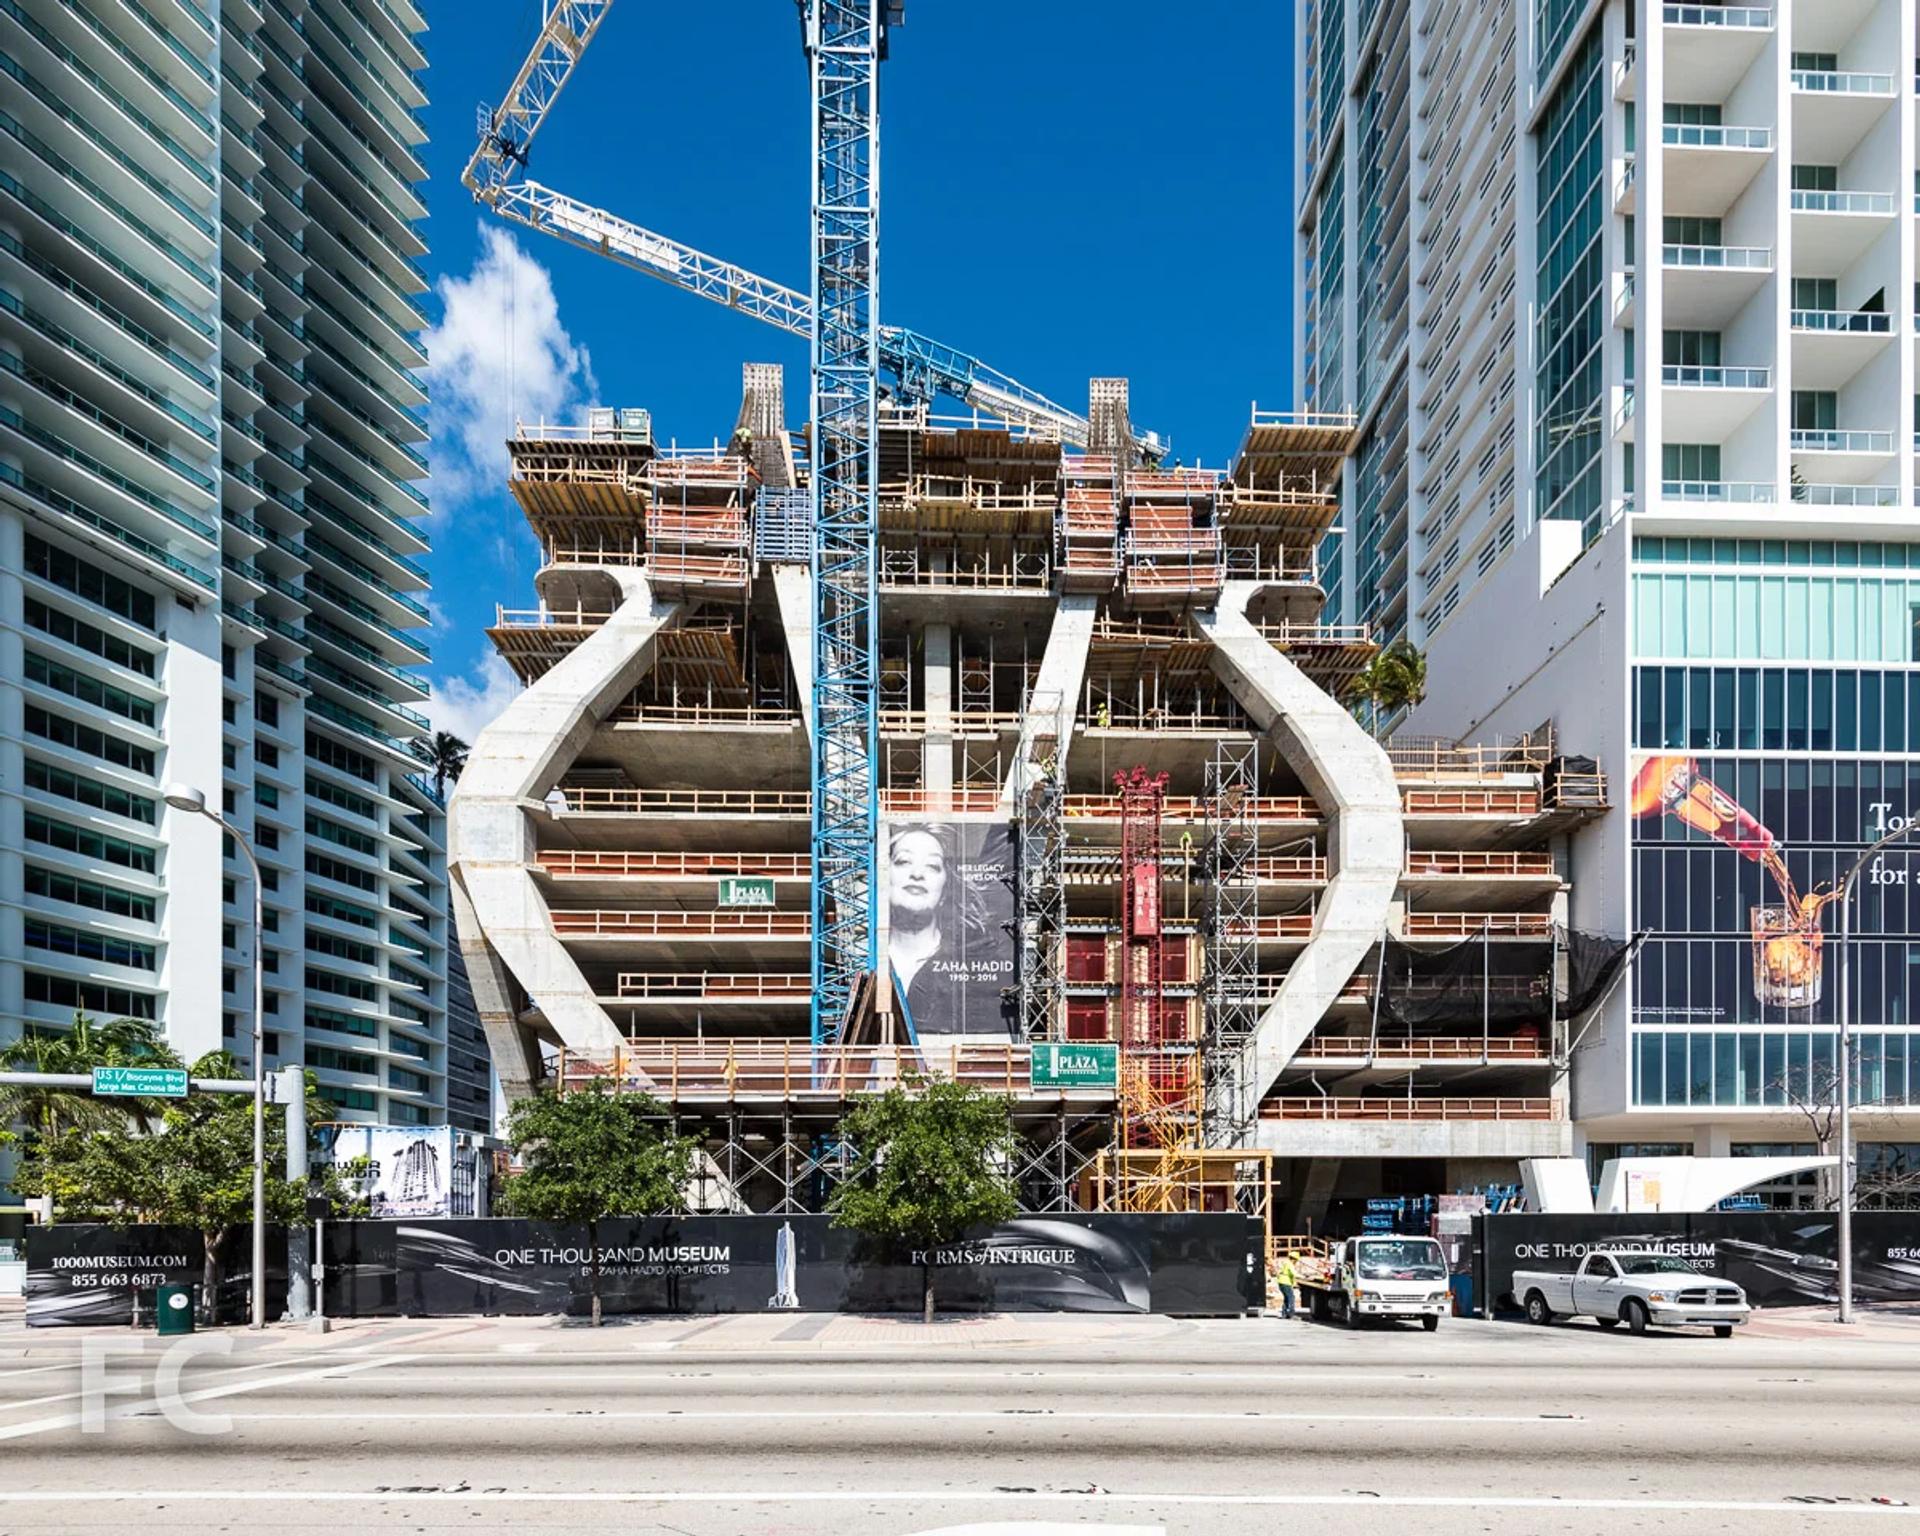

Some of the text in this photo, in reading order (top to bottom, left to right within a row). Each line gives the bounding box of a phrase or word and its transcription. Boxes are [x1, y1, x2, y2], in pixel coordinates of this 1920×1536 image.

[974, 864, 1005, 872] LEGACY
[1869, 856, 1908, 885] for
[736, 886, 768, 899] PLAZA
[932, 961, 1014, 972] ZAHA HADID
[1059, 1056, 1098, 1069] PLAZA
[97, 1070, 112, 1080] US
[165, 1074, 184, 1083] Blvd
[97, 1083, 186, 1093] Jorge Mas Canosa Blvd
[495, 1246, 730, 1264] ONE THOUSAND MUSEUM
[990, 1249, 1075, 1264] INTRIGUE
[1515, 1244, 1549, 1258] ONE
[1646, 1243, 1715, 1257] MUSEUM
[1887, 1248, 1907, 1258] 855
[52, 1255, 188, 1269] 1000MUSEUM.COM
[598, 1266, 628, 1276] ZAHA
[667, 1264, 730, 1275] ARCHITECTS
[72, 1273, 167, 1286] 855 663 6873
